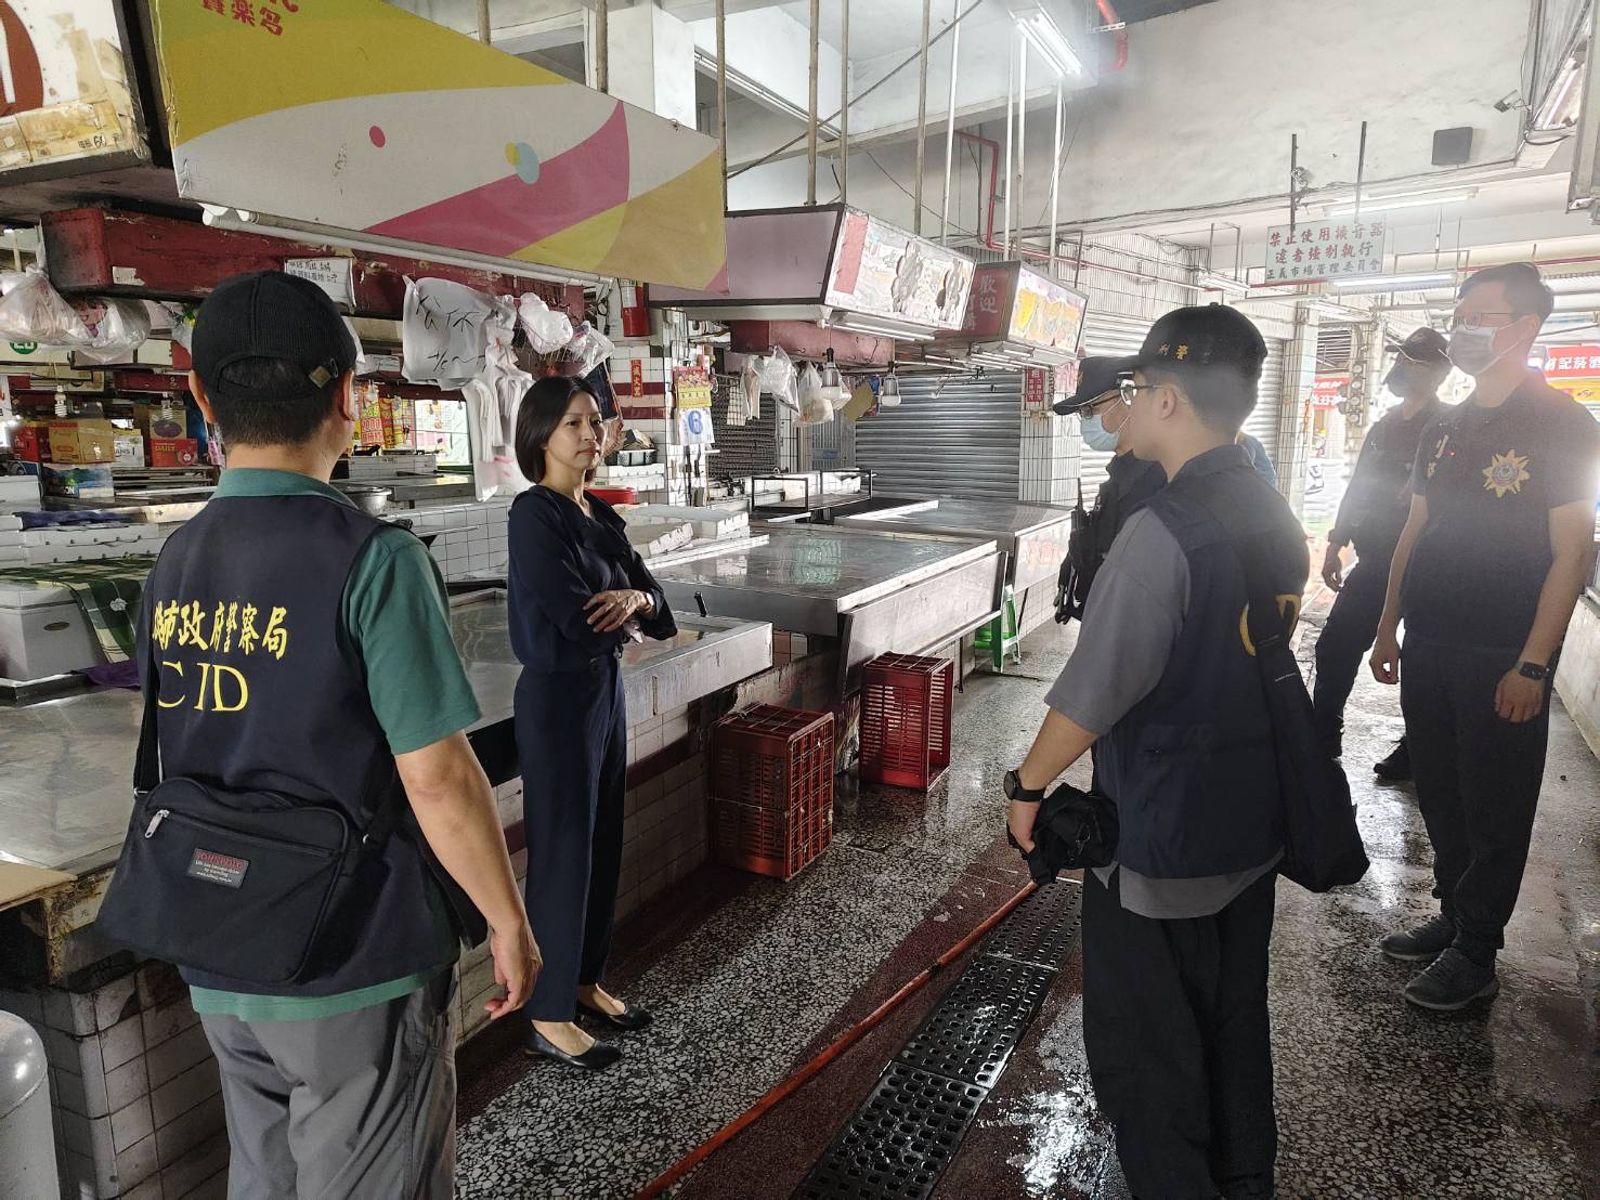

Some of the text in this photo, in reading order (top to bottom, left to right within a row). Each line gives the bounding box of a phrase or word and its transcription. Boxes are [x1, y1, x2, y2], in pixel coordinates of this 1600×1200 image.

[1269, 222, 1383, 247] 禁止使用擴音器
[1275, 240, 1373, 264] 違者強制執行
[158, 661, 249, 712] CID
